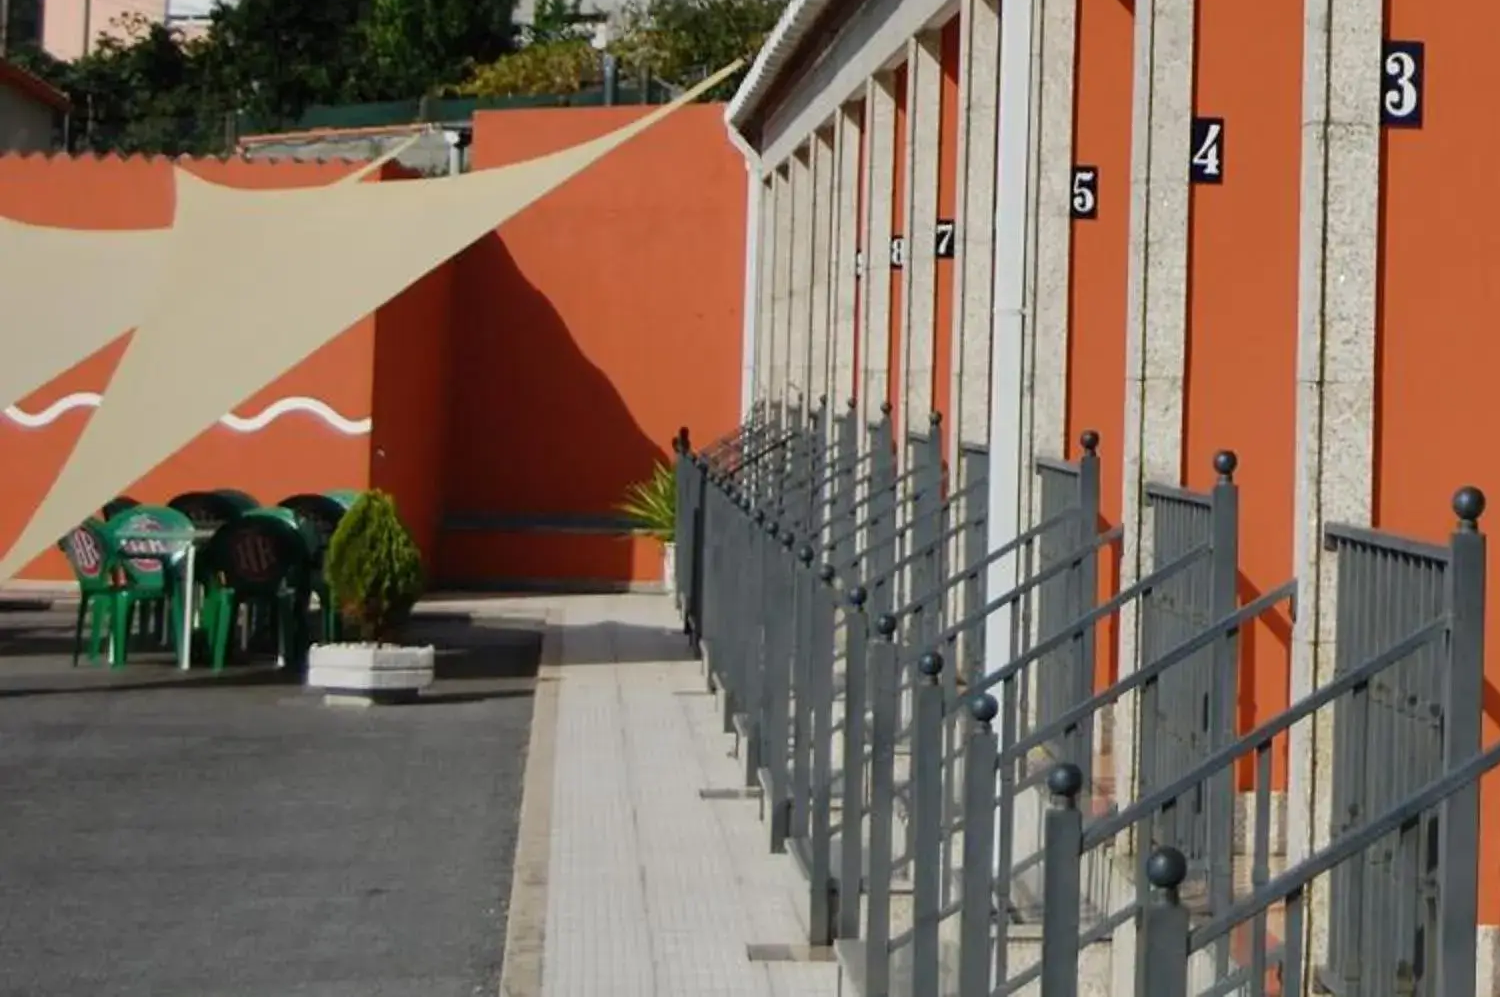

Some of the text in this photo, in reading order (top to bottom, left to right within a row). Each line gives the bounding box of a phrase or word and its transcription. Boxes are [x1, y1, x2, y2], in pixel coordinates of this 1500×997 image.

[1385, 51, 1417, 118] 3
[1192, 124, 1221, 175] 4
[1073, 171, 1095, 213] 5
[892, 238, 904, 265] 8
[937, 224, 953, 255] 7
